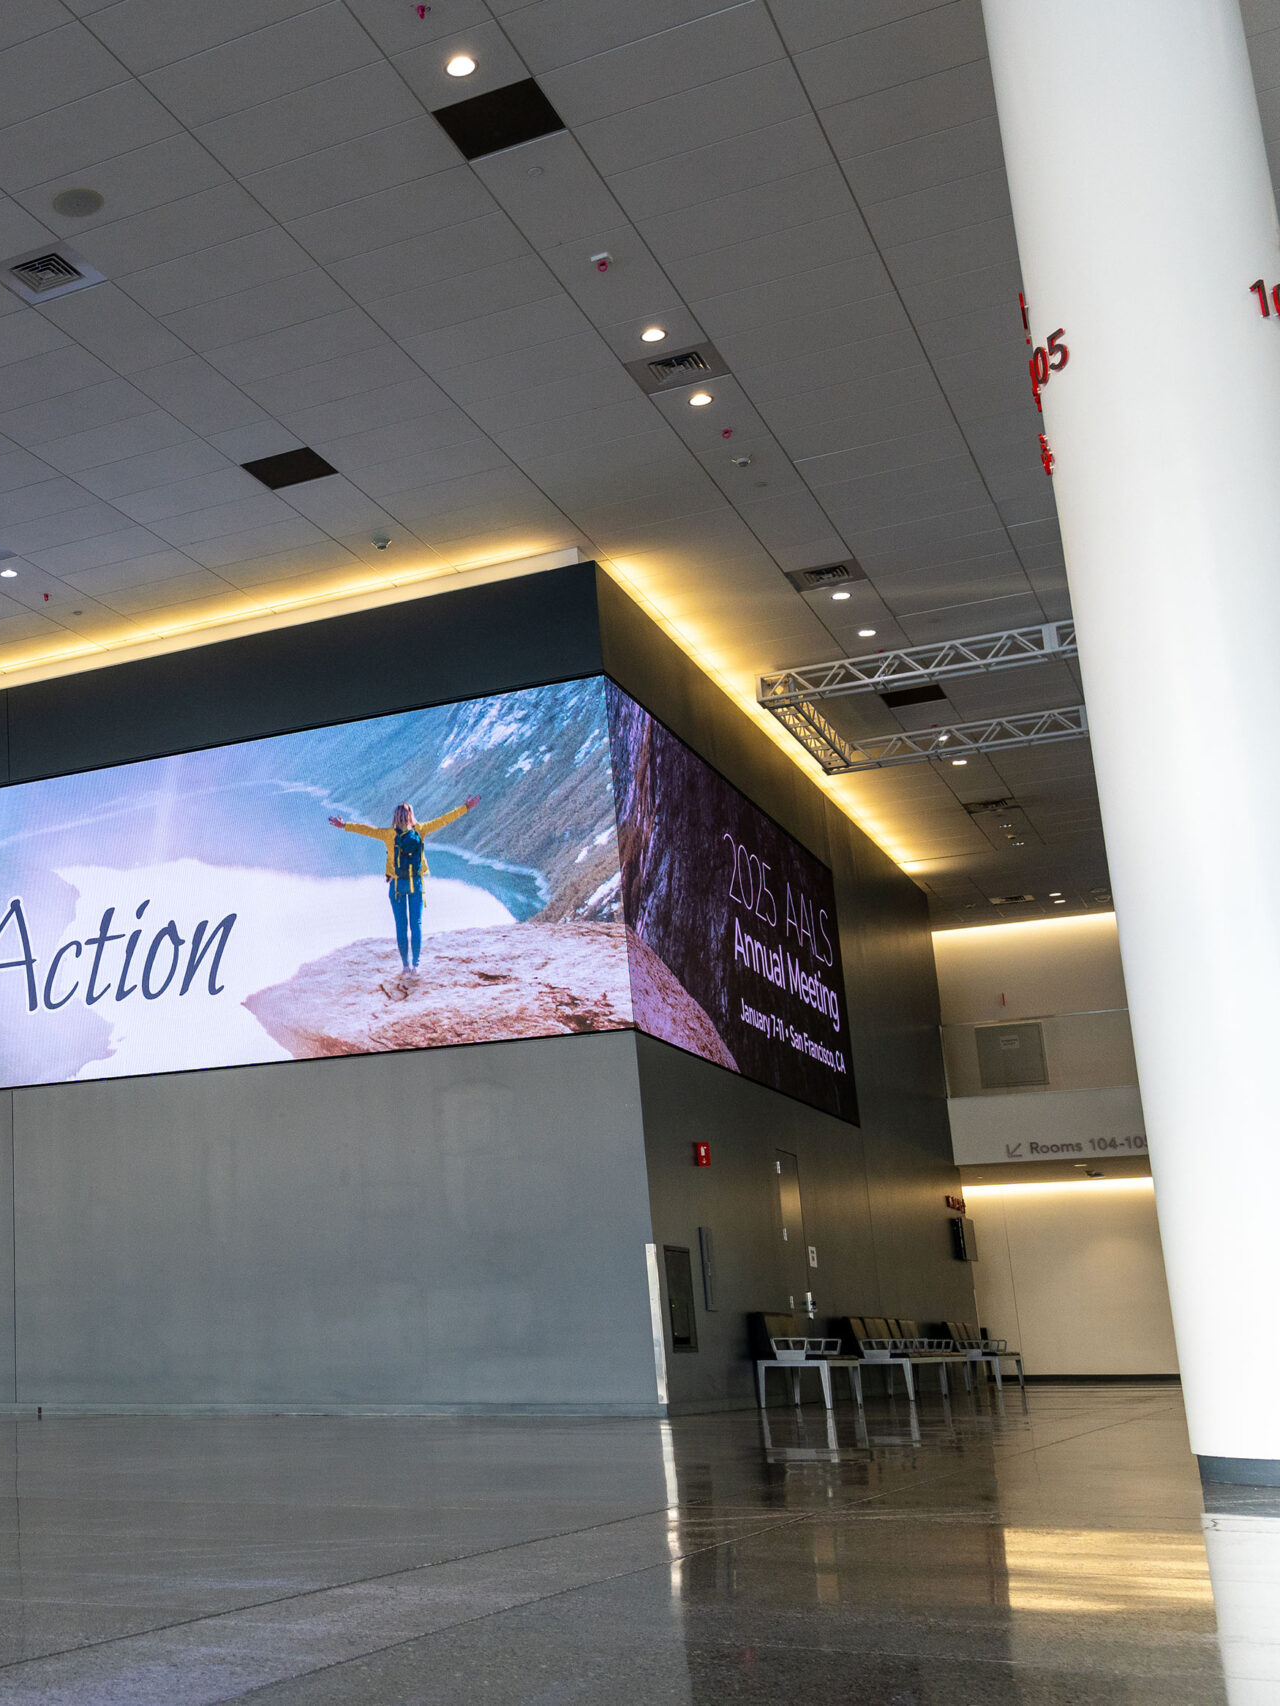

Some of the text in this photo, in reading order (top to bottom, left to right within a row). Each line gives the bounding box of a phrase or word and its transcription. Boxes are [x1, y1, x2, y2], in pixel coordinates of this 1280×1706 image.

[723, 833, 833, 967] 2025 AALS
[734, 917, 840, 1032] Annual Meeting
[740, 997, 847, 1075] January 7-11 San Francisco, CA
[1029, 1134, 1148, 1155] Rooms 104-10
